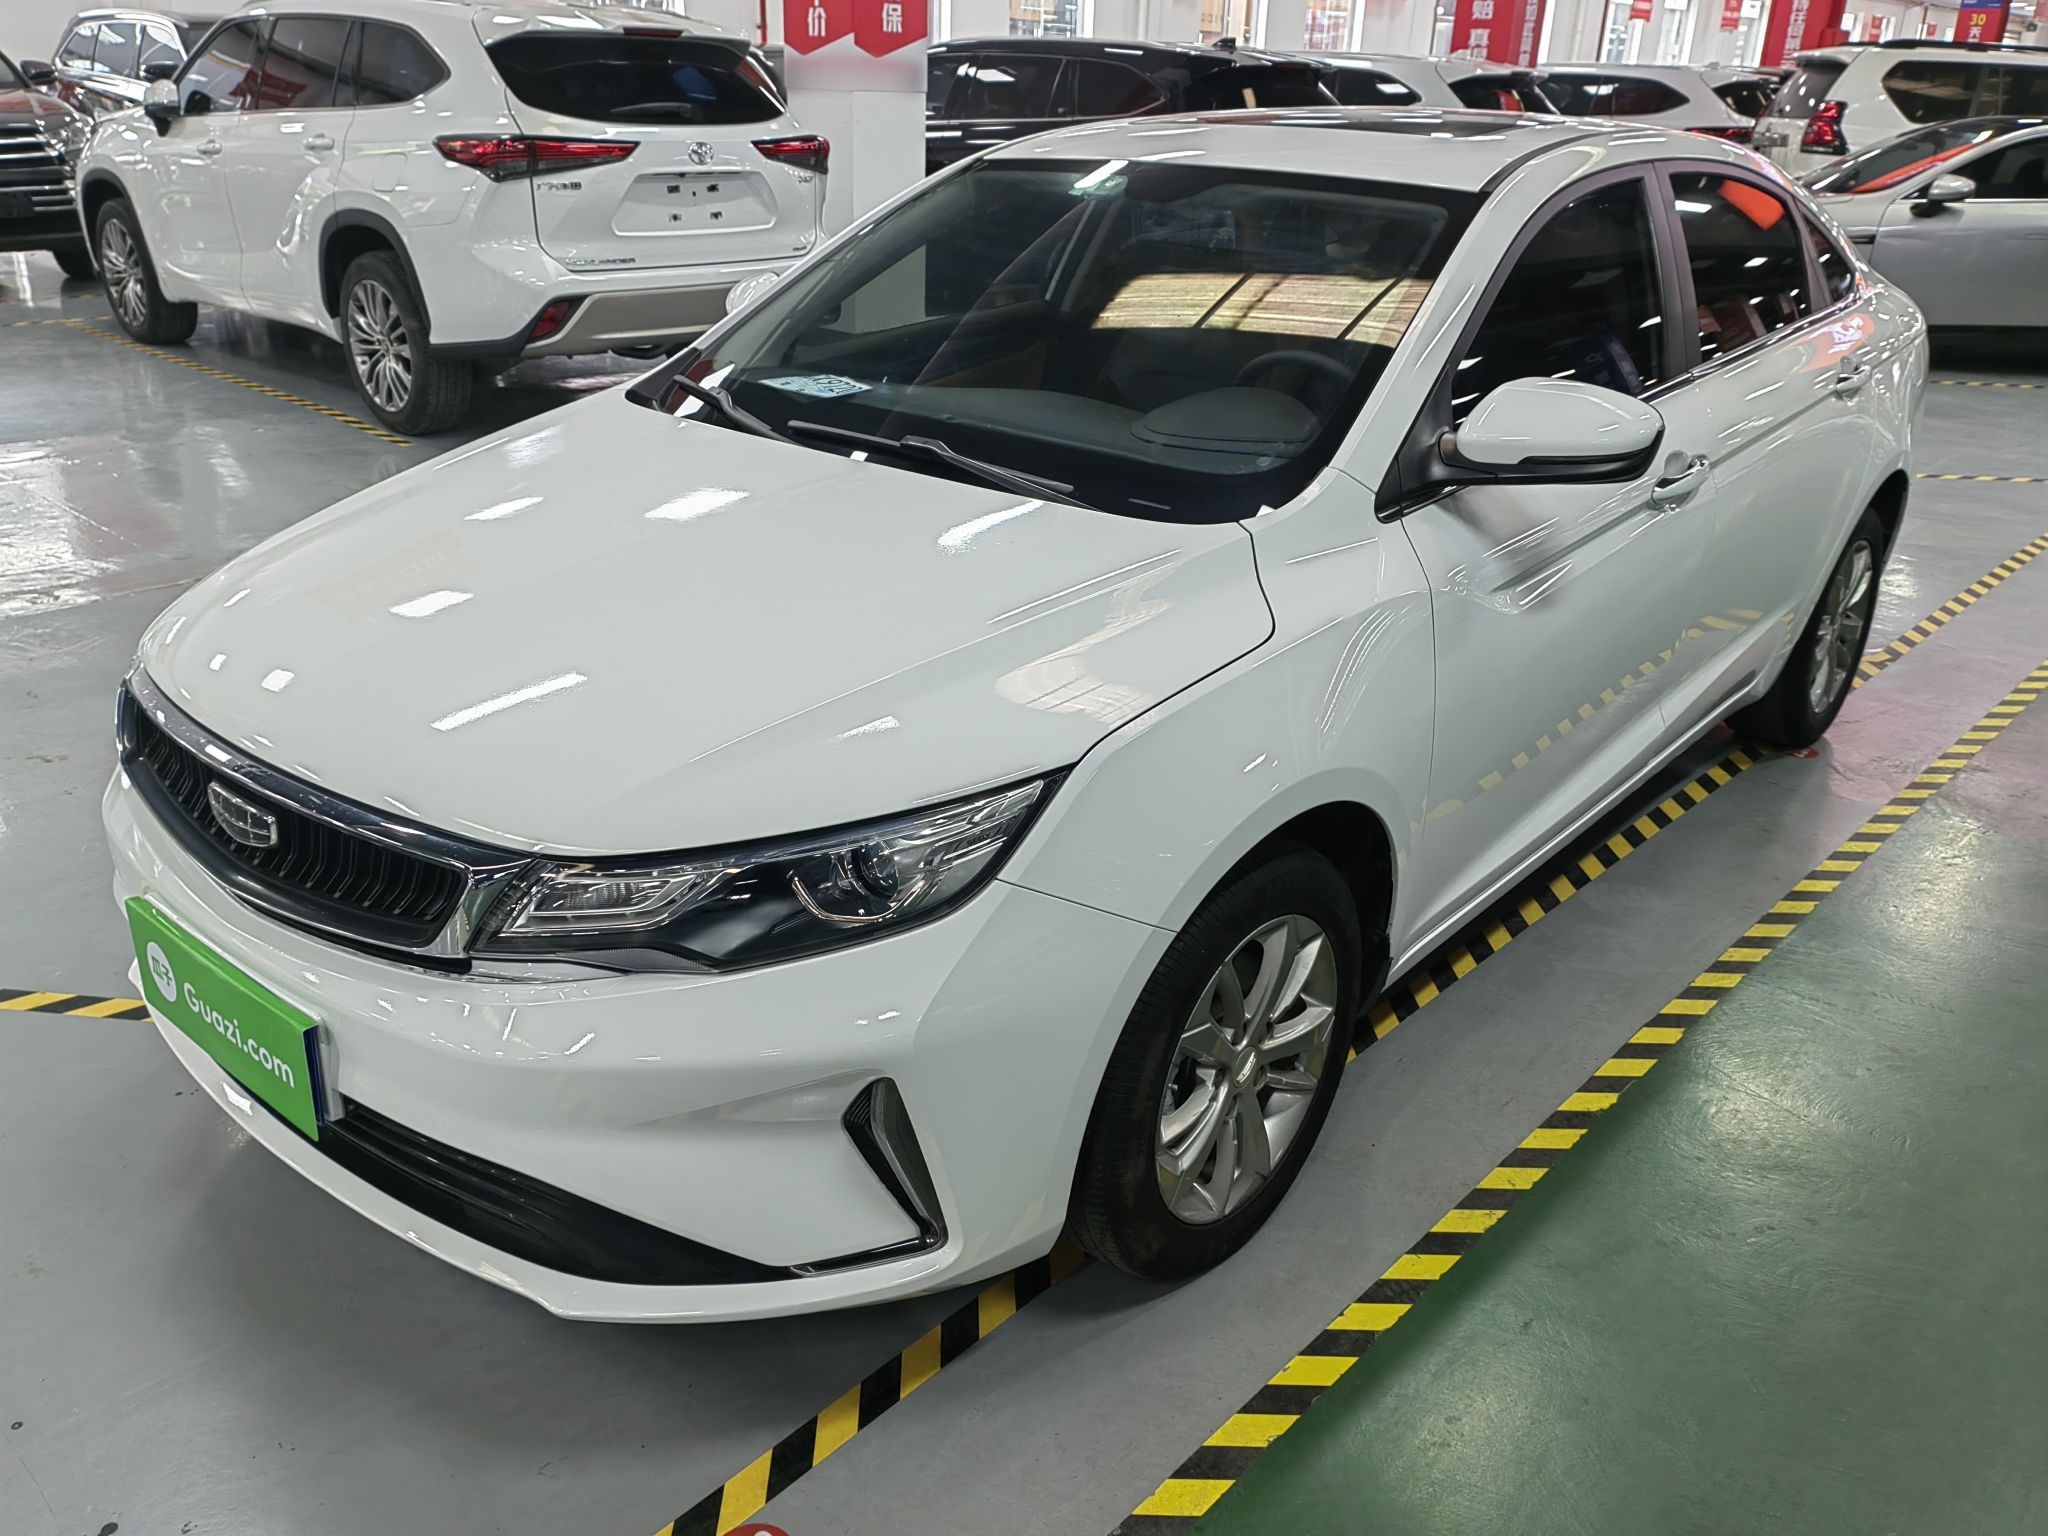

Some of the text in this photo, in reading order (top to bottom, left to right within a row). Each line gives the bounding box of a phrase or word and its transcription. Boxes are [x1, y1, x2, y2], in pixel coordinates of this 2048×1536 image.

[807, 0, 827, 37] 价
[881, 0, 902, 33] 保
[1969, 13, 1987, 26] 30
[151, 955, 173, 987] 瓜子
[183, 982, 295, 1088] Guazi.com
